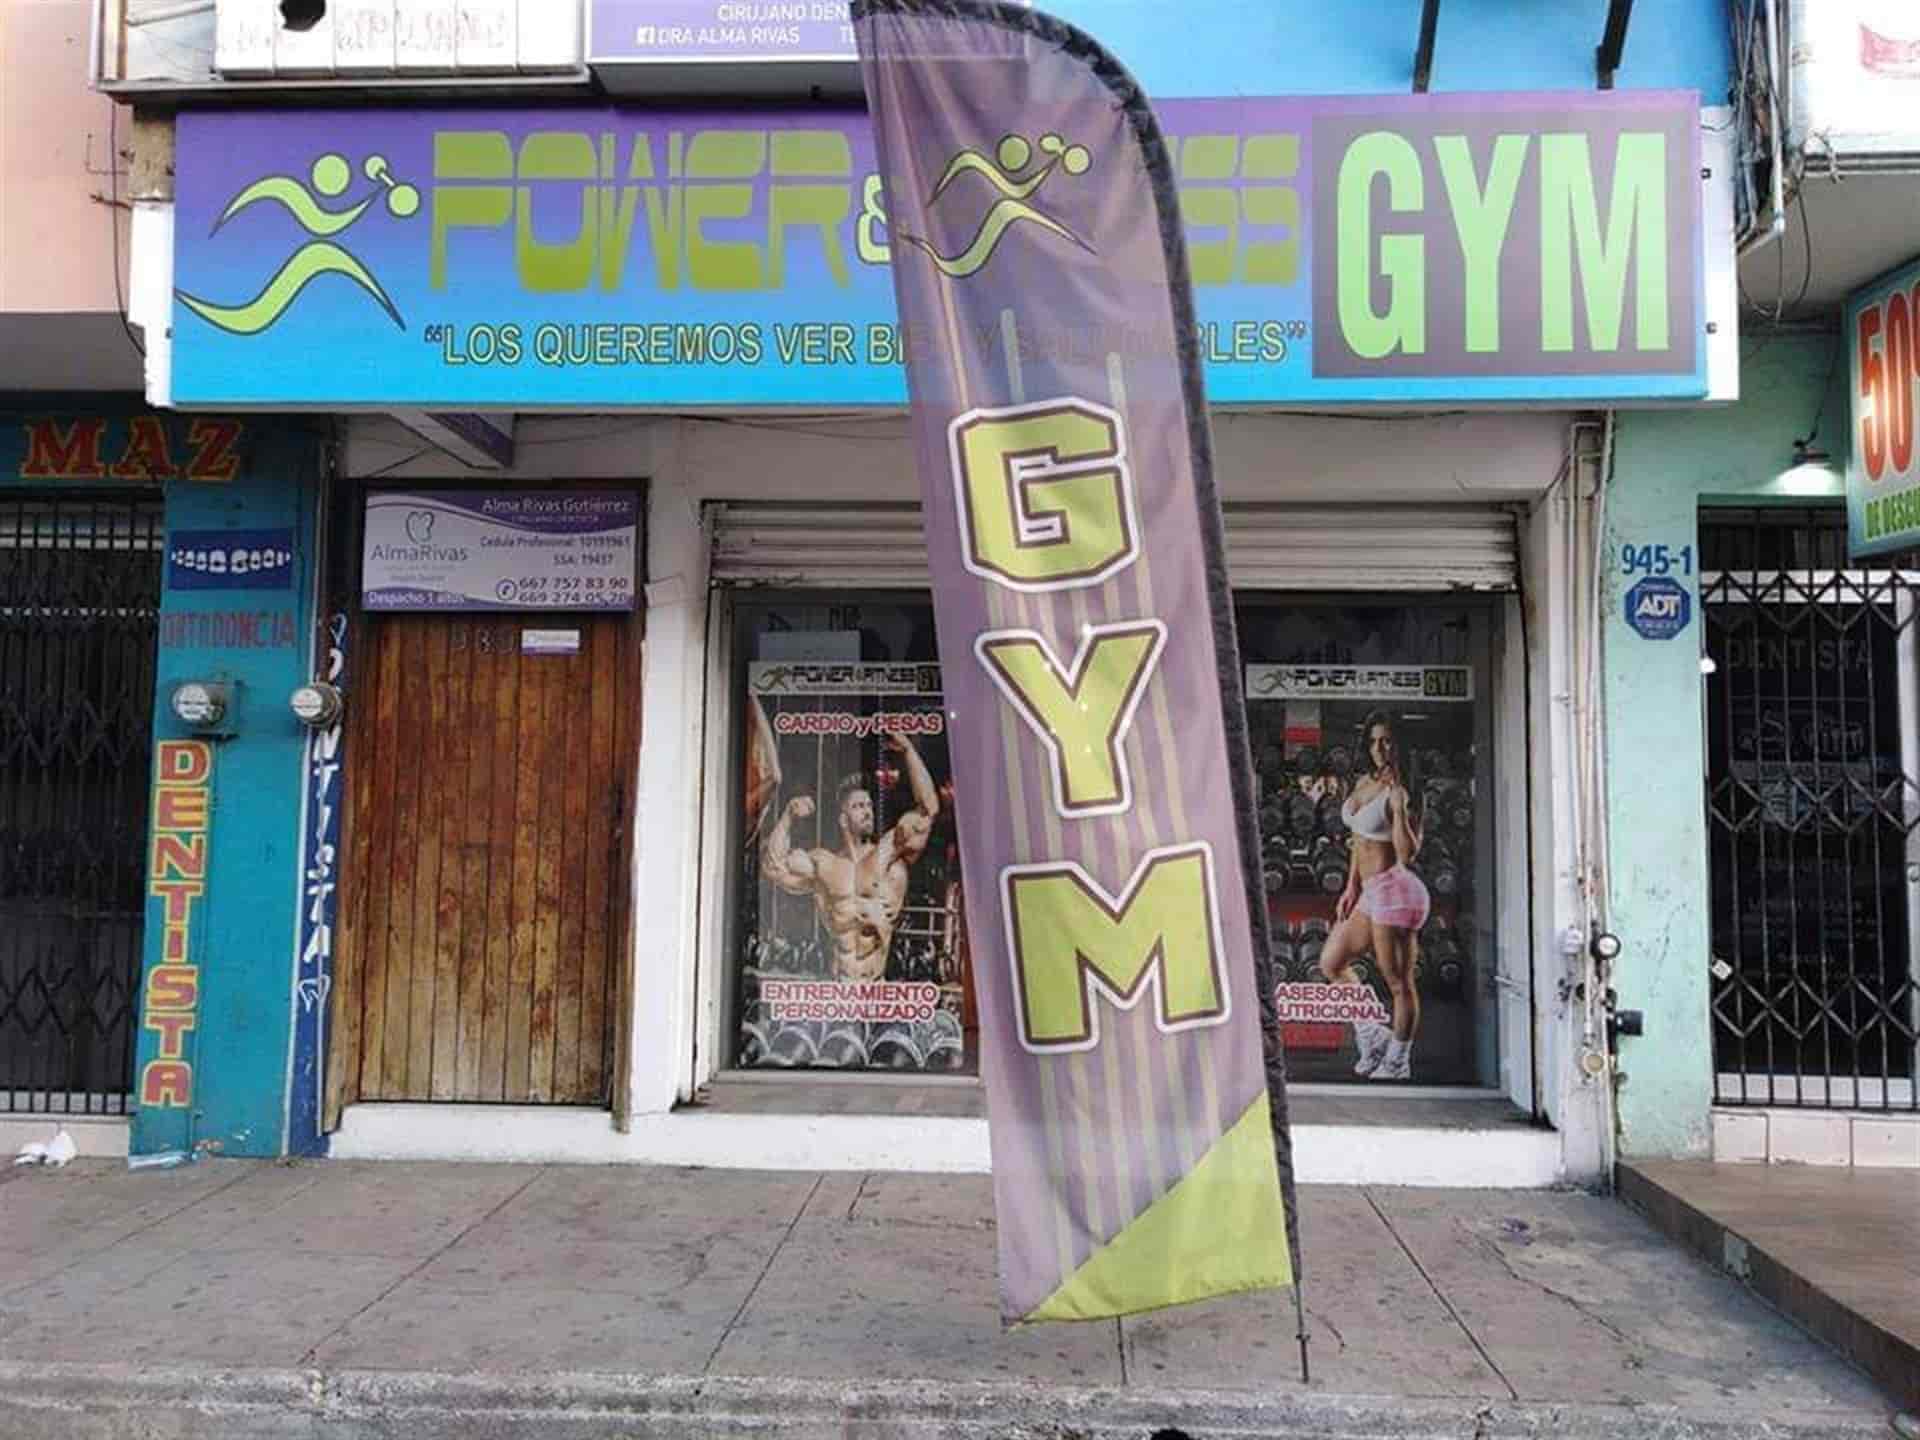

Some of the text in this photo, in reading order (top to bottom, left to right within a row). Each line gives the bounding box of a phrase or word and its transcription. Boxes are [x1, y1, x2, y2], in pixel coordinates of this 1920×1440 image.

[717, 3, 807, 22] CIRUJANO
[658, 25, 801, 45] DRA ALMA RIVAS
[429, 130, 853, 294] POWER
[1336, 130, 1671, 360] GYM
[535, 321, 762, 369] QUEREMOS
[774, 321, 857, 366] VER
[482, 497, 520, 513] Alma
[523, 497, 561, 513] Rivas
[370, 544, 470, 561] AlmaRivas
[1621, 543, 1692, 577] 945-1
[1635, 593, 1682, 618] ADT
[1426, 671, 1466, 696] GYM
[774, 711, 945, 738] CARDIO y PESAS
[949, 397, 1230, 1053] GYM
[141, 740, 213, 1107] DENTISTA
[763, 982, 939, 1003] ENTRENAMIENTO
[772, 1002, 936, 1023] PERSONALIZADO
[1278, 1001, 1389, 1021] UTRICIONAL
